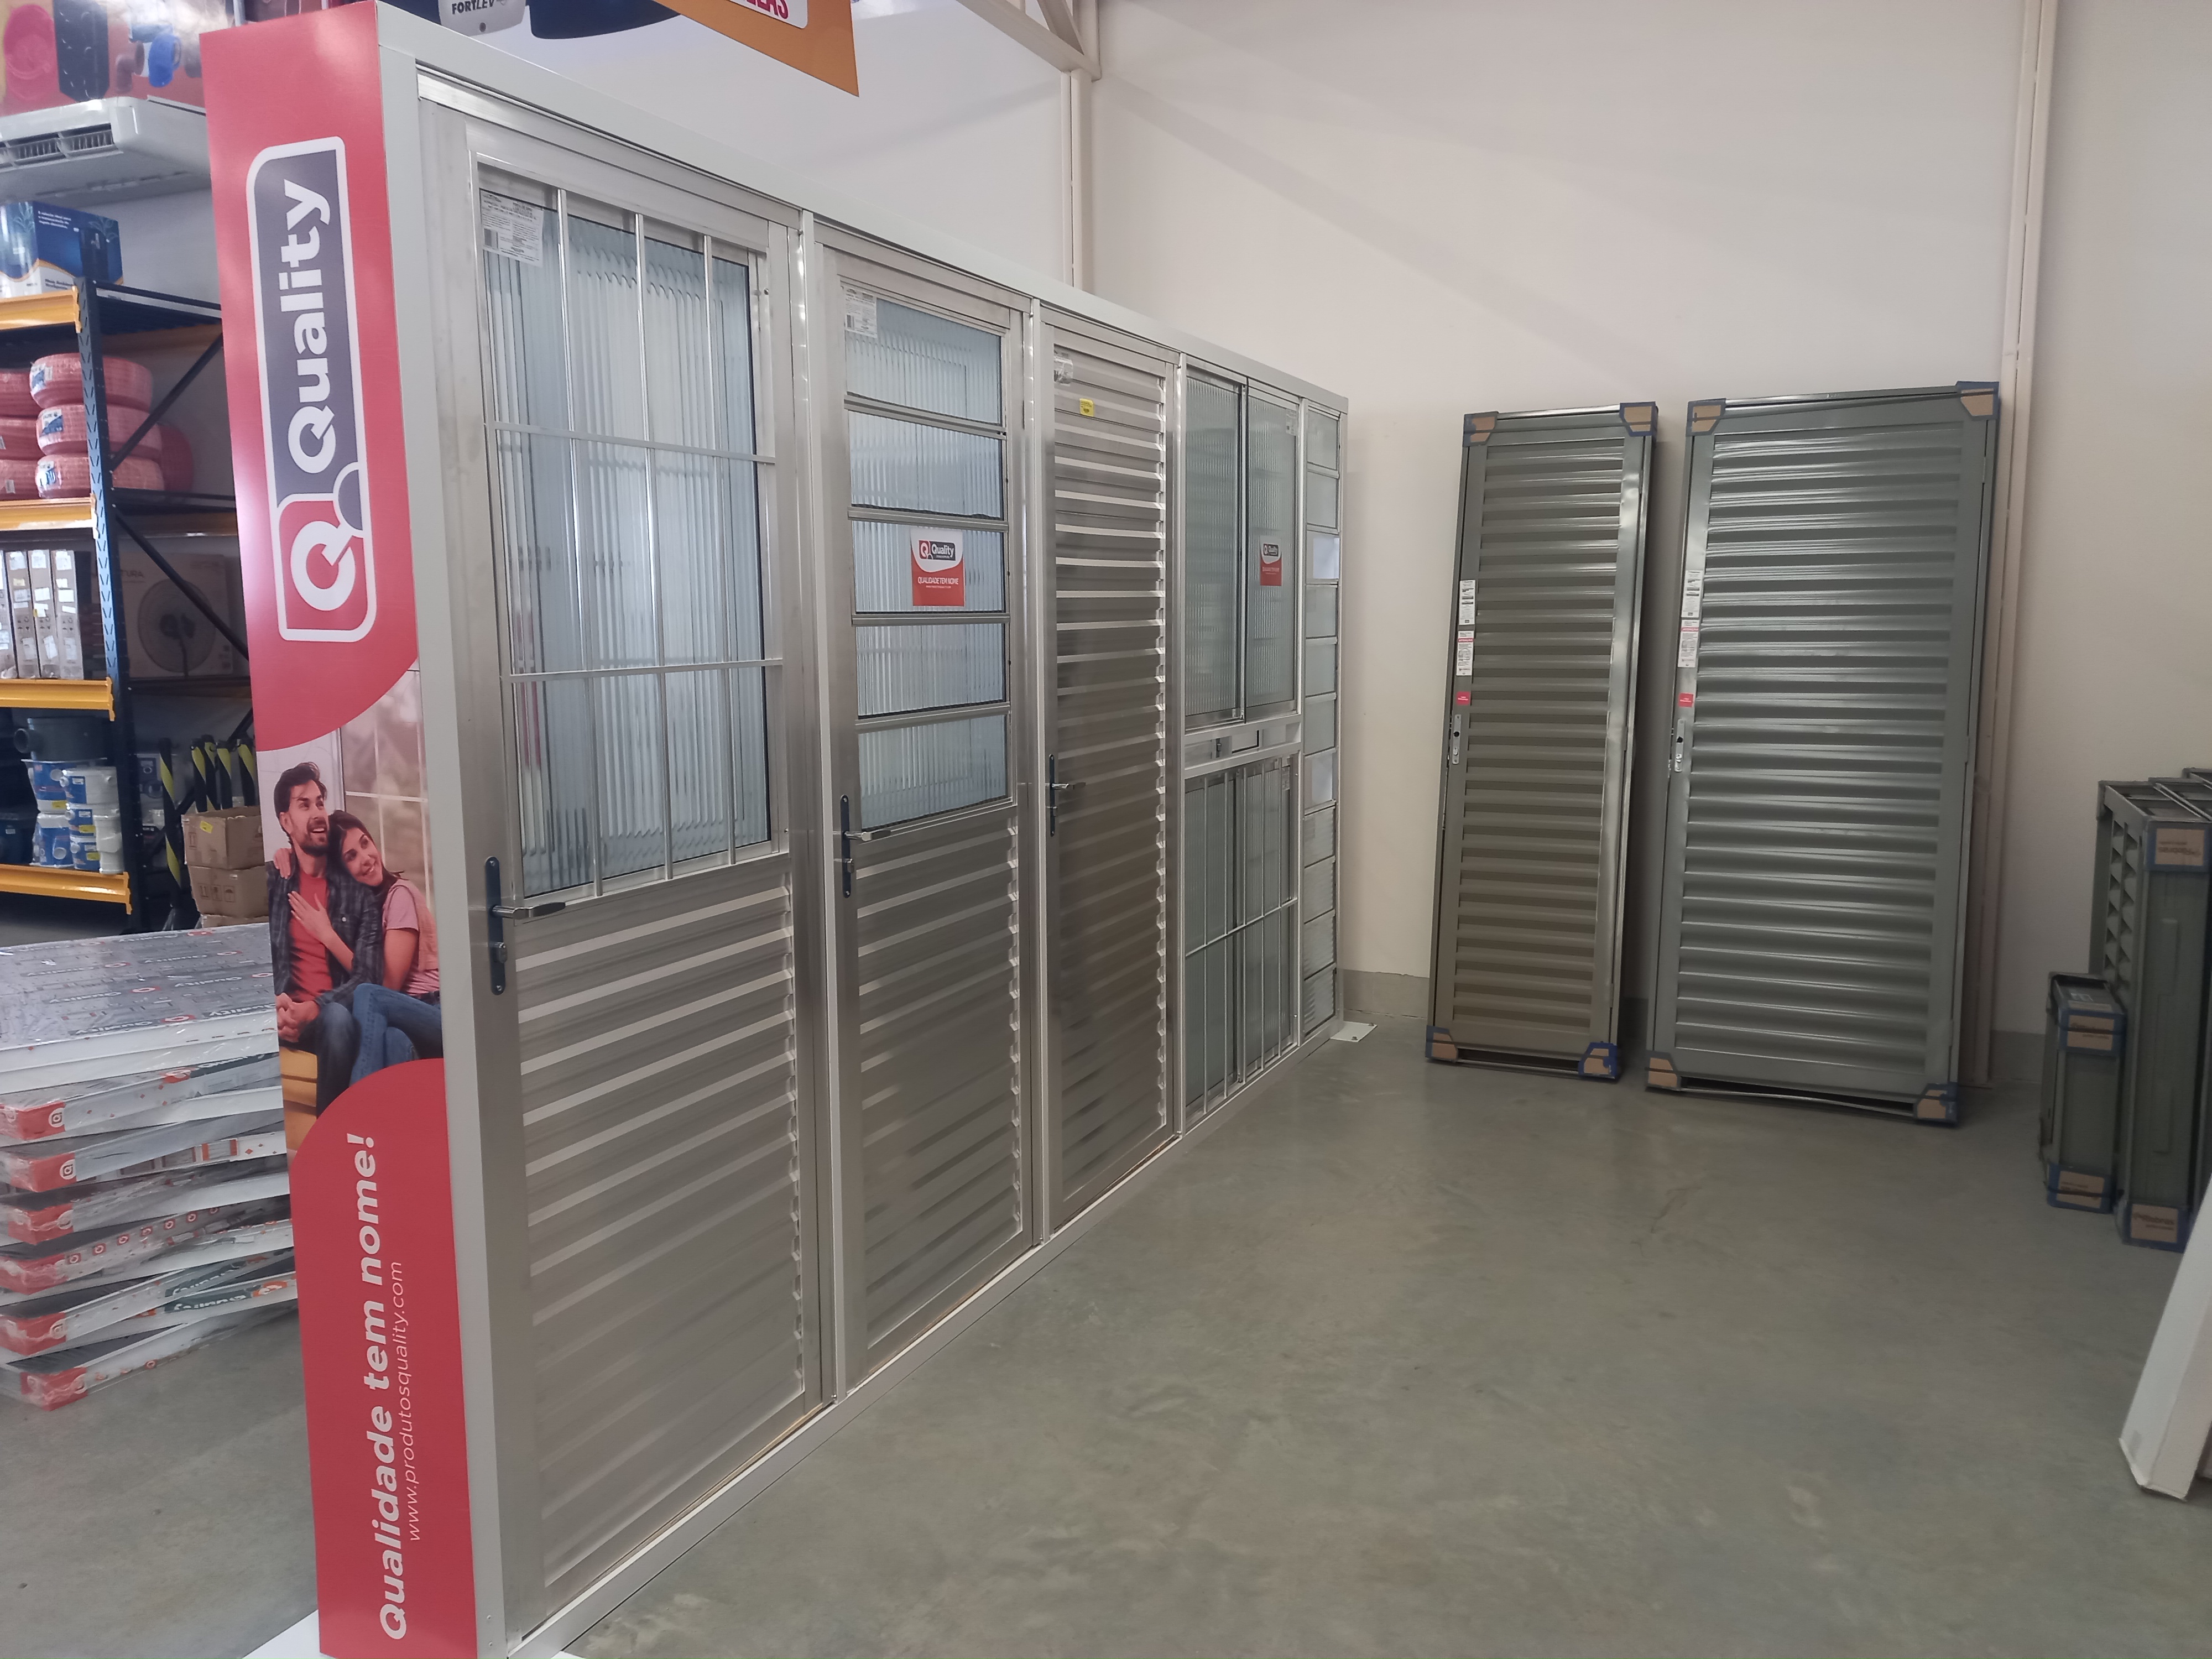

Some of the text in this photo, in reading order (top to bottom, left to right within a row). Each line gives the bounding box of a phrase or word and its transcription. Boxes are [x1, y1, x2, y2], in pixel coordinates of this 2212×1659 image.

[452, 0, 494, 14] FORTLEV
[279, 179, 336, 474] Quality
[931, 544, 954, 558] Quality
[917, 576, 940, 585] QUALIDADE
[175, 977, 242, 987] Quality
[75, 1021, 153, 1035] Quality
[347, 1133, 406, 1640] Qualidade tem nome!
[391, 1261, 420, 1541] www.produtosquality.com
